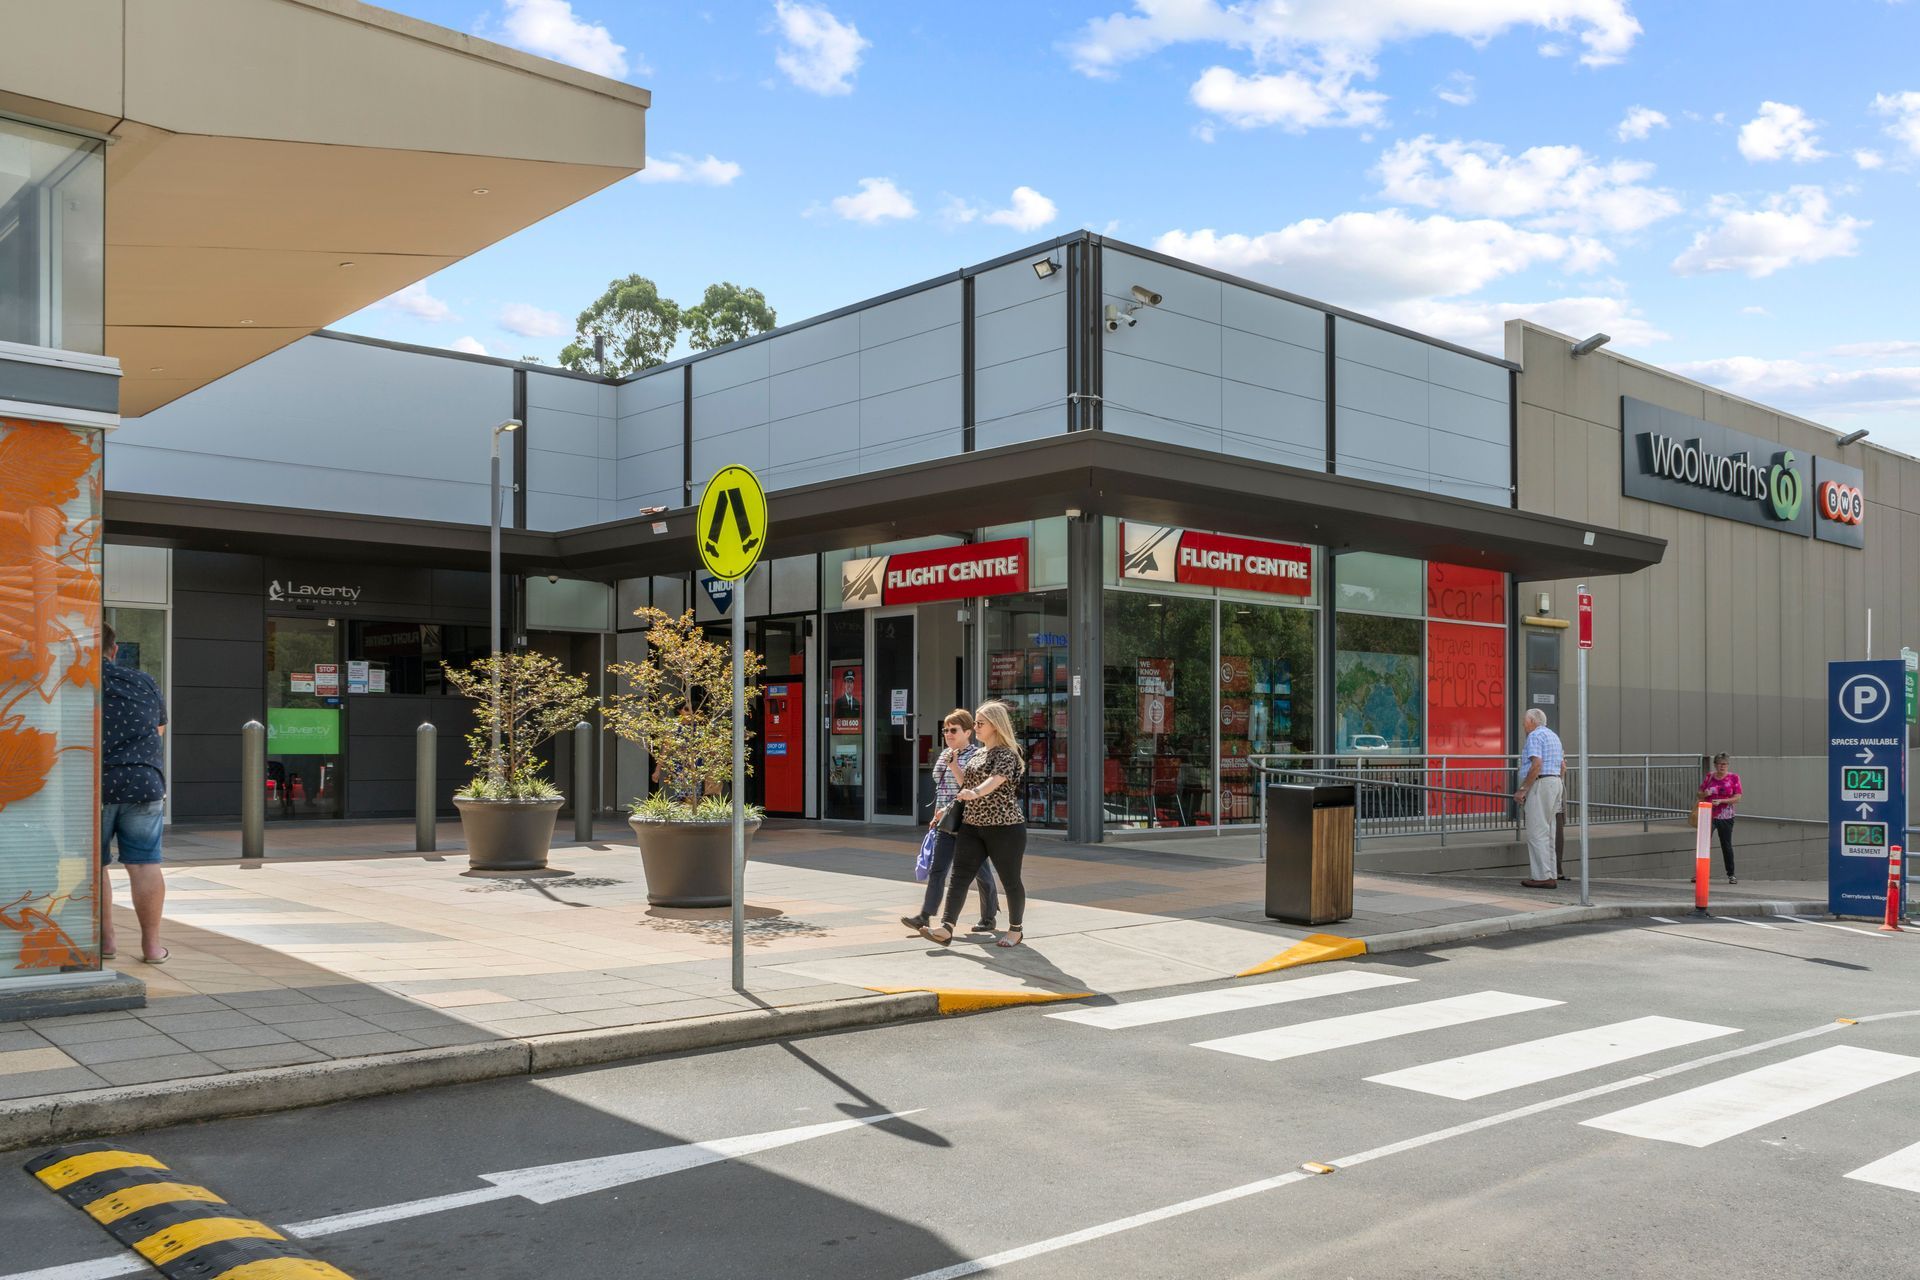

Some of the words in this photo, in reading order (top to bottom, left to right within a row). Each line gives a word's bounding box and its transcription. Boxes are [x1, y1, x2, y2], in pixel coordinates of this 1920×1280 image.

[1649, 431, 1767, 500] Woolworths
[1827, 488, 1862, 517] BWS
[888, 564, 947, 589] FLIGHT
[949, 555, 1019, 581] CENTRE
[1180, 547, 1243, 572] FLIGHT
[1245, 555, 1308, 579] CENTRE
[288, 581, 360, 600] Laverty
[288, 598, 357, 606] PATHOLOGY
[1854, 686, 1877, 714] P
[1831, 738, 1858, 746] SPACES
[1860, 738, 1899, 746] AVAILABLE
[1847, 771, 1883, 789] 024
[1853, 792, 1876, 800] UPPER
[1846, 826, 1883, 844] 026
